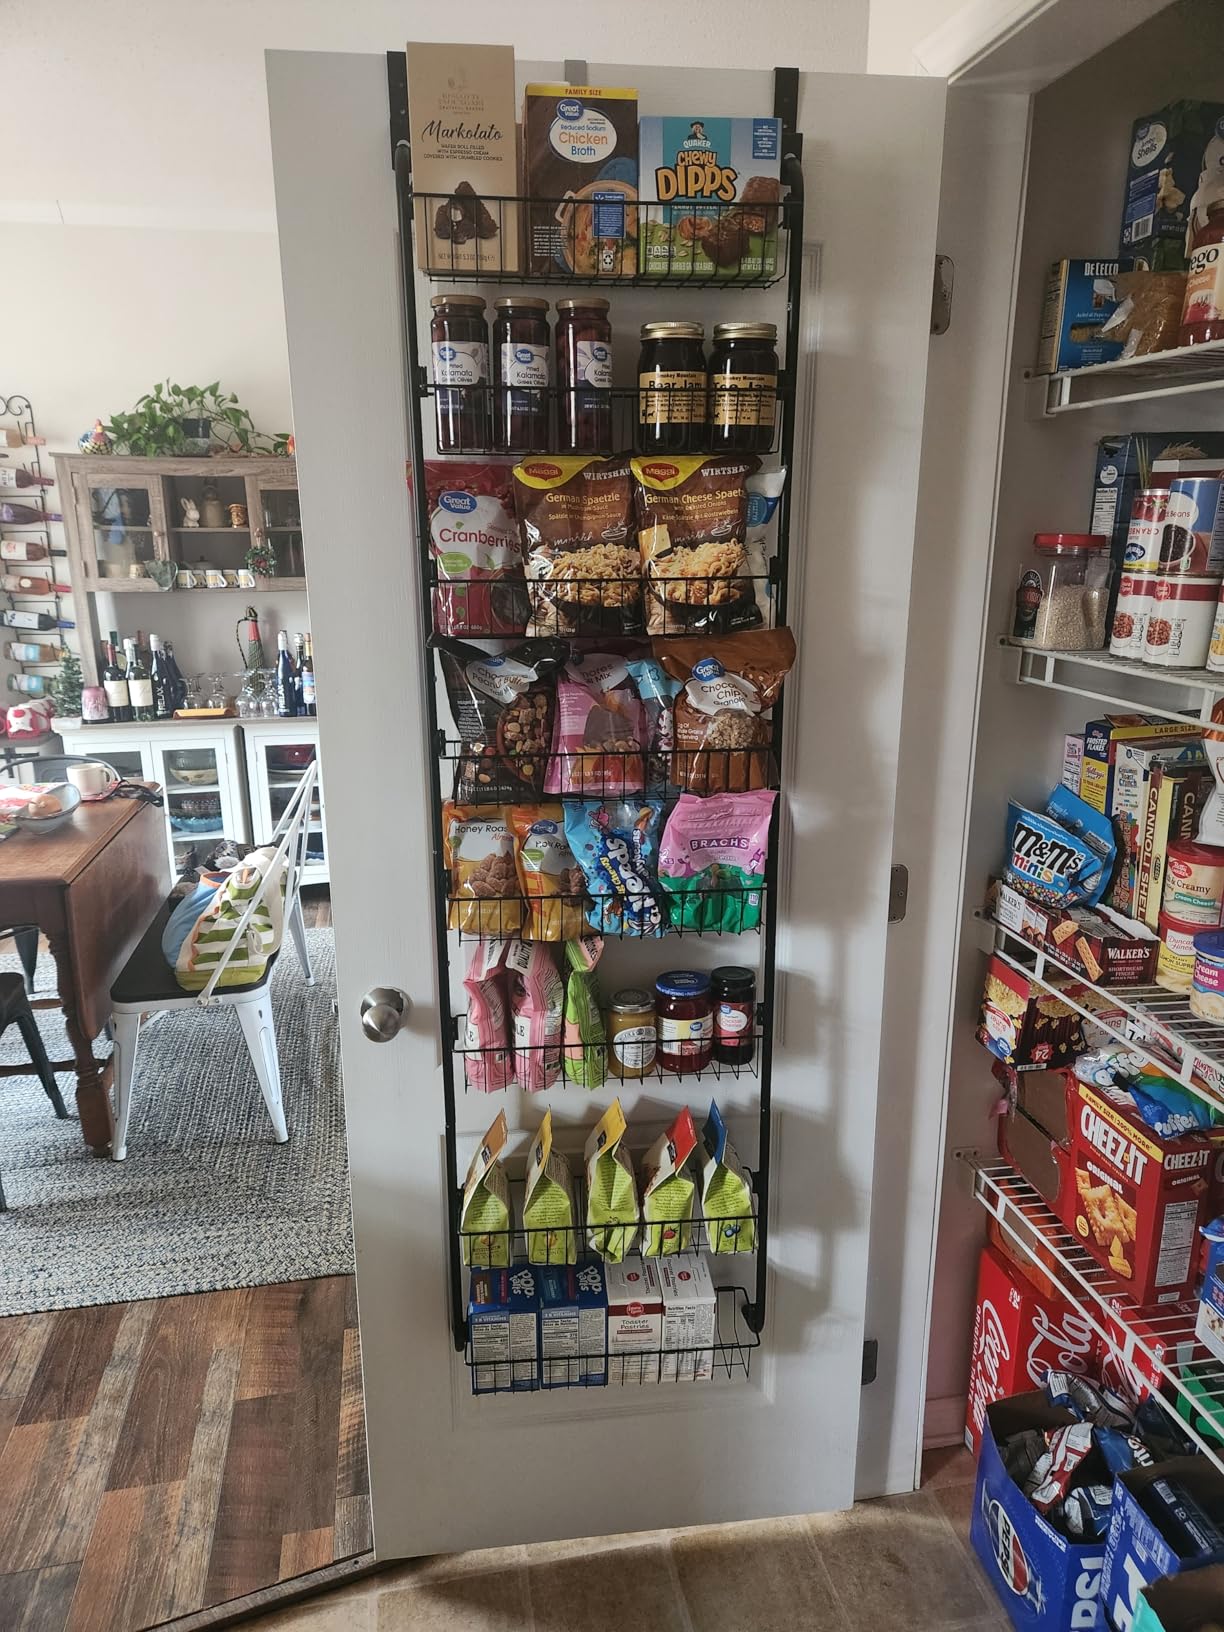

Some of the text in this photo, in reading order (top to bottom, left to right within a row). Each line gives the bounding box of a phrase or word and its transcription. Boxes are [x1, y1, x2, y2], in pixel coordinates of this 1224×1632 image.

[560, 103, 580, 113] Great
[421, 119, 503, 143] Markolato
[559, 131, 608, 145] Chicken
[571, 145, 596, 156] Broth
[683, 139, 712, 149] QUAKER
[1137, 143, 1158, 161] Shells
[656, 165, 737, 201] DIPPS
[1189, 248, 1219, 274] ego
[516, 372, 546, 380] Kalamata
[529, 467, 631, 481] Maggi WIRTSHAU
[443, 495, 471, 507] Great
[546, 492, 620, 505] German Spaetzle
[646, 491, 712, 505] German Cheese
[450, 503, 472, 511] Value
[439, 528, 521, 554] Cranberries
[697, 662, 721, 676] Great
[157, 687, 165, 716] RELAX
[1154, 727, 1178, 735] LARGE
[1086, 737, 1107, 745] FROSTED
[1087, 743, 1105, 751] FLAKES
[1119, 779, 1138, 788] Crunch
[1180, 792, 1195, 842] CANN
[455, 824, 483, 834] Honey
[1144, 787, 1158, 865] CANNOLI
[1013, 853, 1053, 883] minis
[605, 838, 657, 914] Nerds
[1177, 879, 1212, 895] Creamy
[1002, 893, 1022, 911] ALKER'S
[1175, 893, 1215, 906] Cream Cheese
[1108, 947, 1150, 960] WALKER'S
[1176, 959, 1194, 969] SUPRE
[1196, 959, 1219, 977] Cream
[1194, 969, 1219, 987] Cheese
[1085, 1093, 1103, 1113] FAMILY
[1103, 1105, 1115, 1121] SIZE
[1086, 1161, 1124, 1195] ORIGINAL
[1171, 1174, 1201, 1187] ORIGINAL
[972, 1304, 982, 1361] ORIGINAL
[1000, 1515, 1011, 1579] PEPSI
